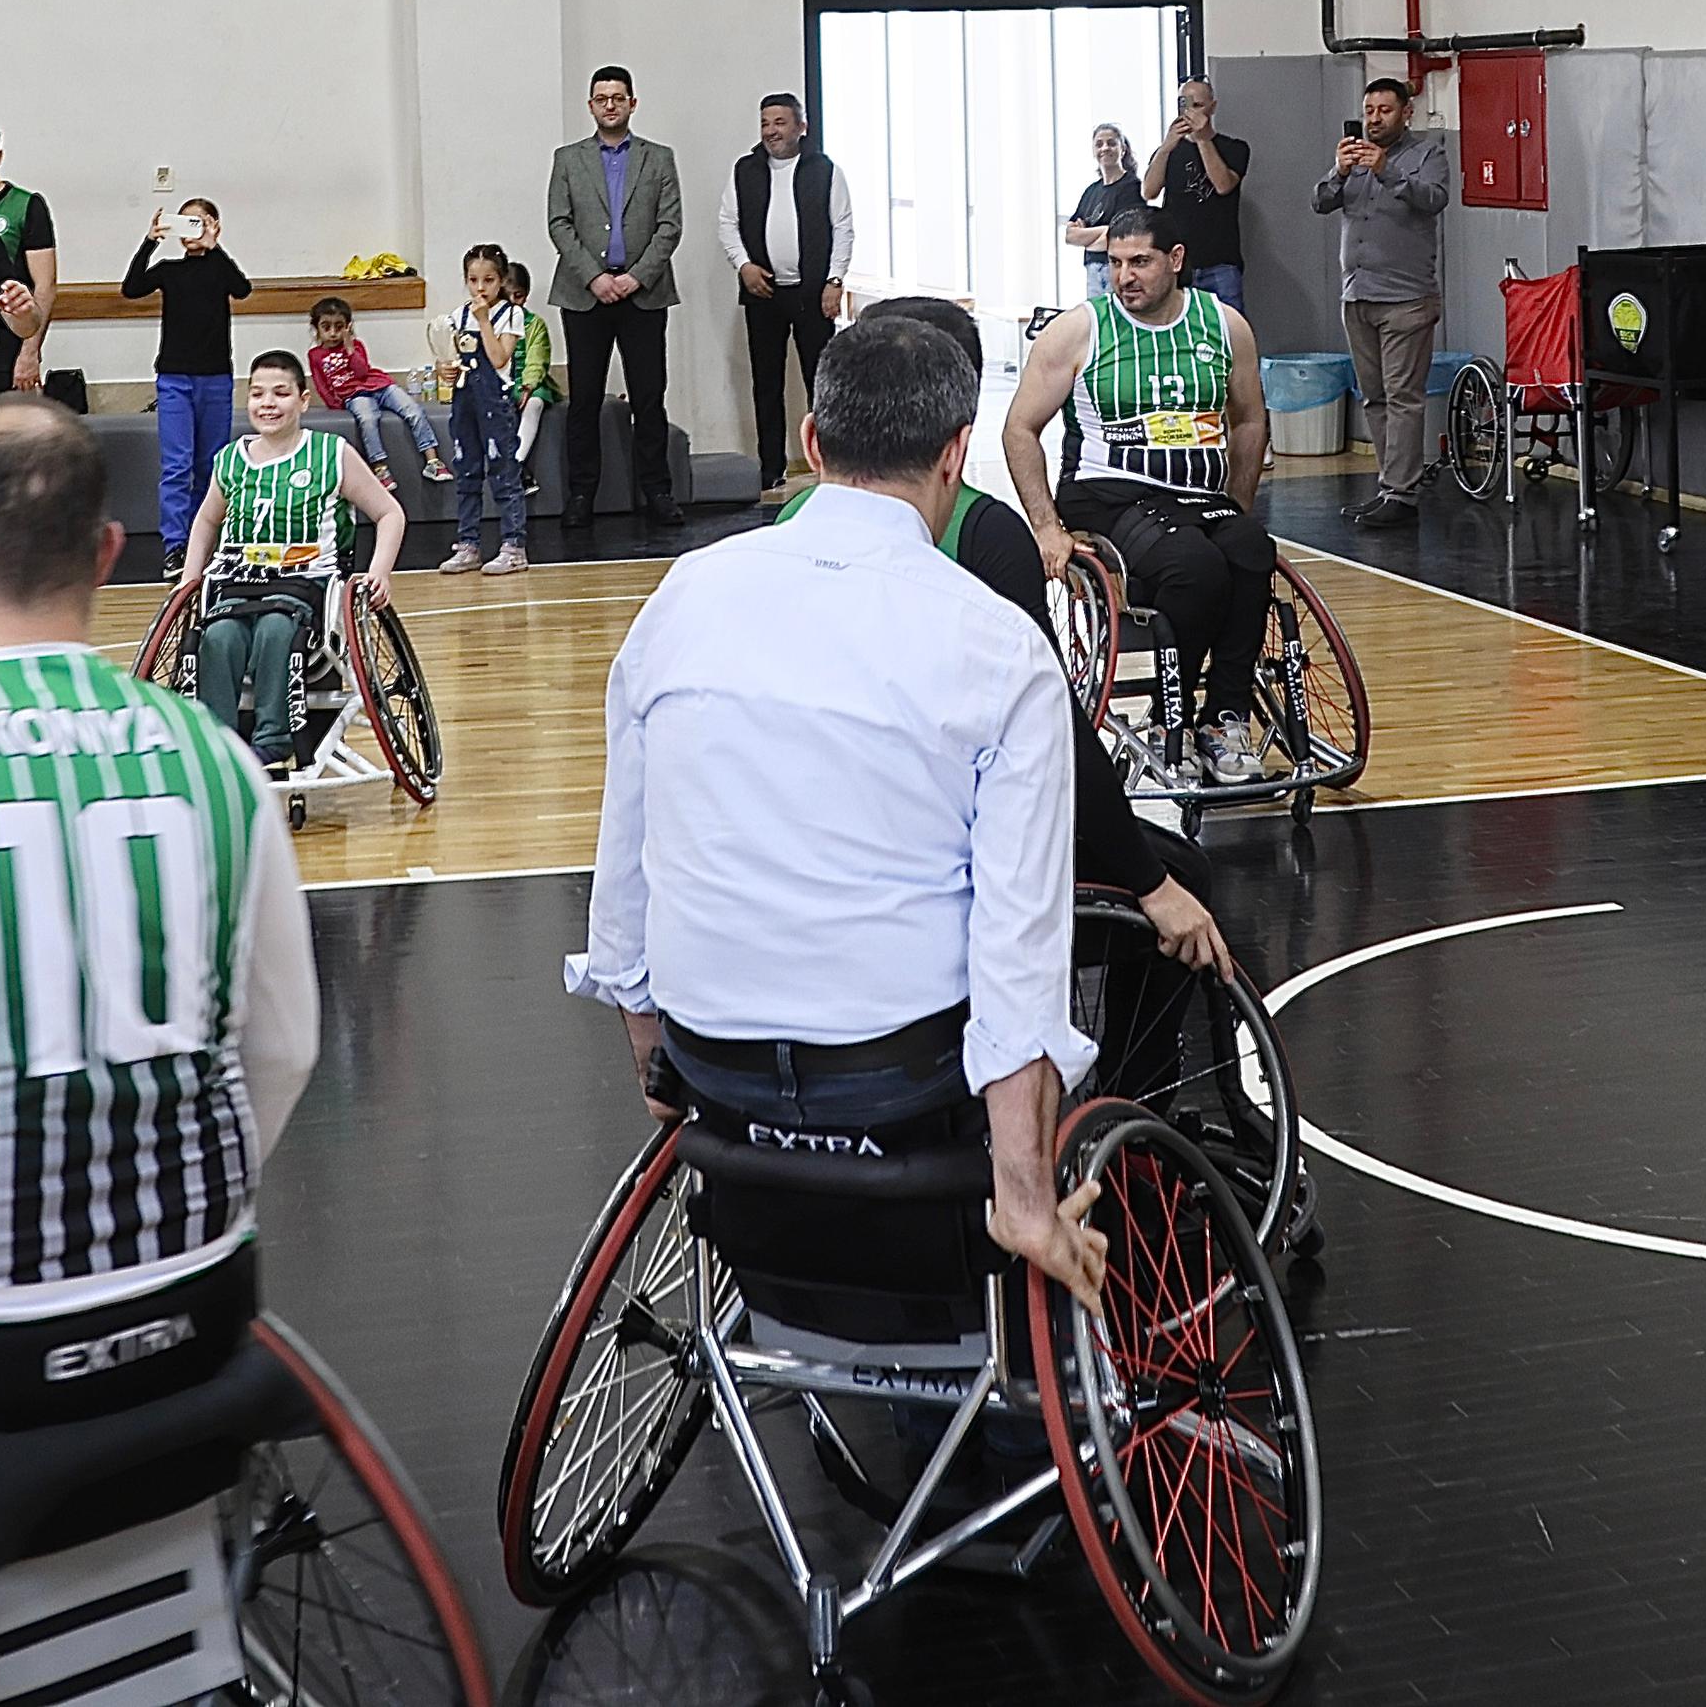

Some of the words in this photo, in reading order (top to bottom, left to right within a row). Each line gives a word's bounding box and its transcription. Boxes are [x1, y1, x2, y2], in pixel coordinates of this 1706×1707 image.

[1147, 374, 1186, 406] 13
[252, 498, 275, 534] 7
[181, 653, 198, 701] EXT
[287, 651, 308, 733] EXTRA
[1165, 647, 1184, 730] EXTRA
[748, 1122, 884, 1158] EXTRA
[851, 1364, 963, 1397] EXTRA
